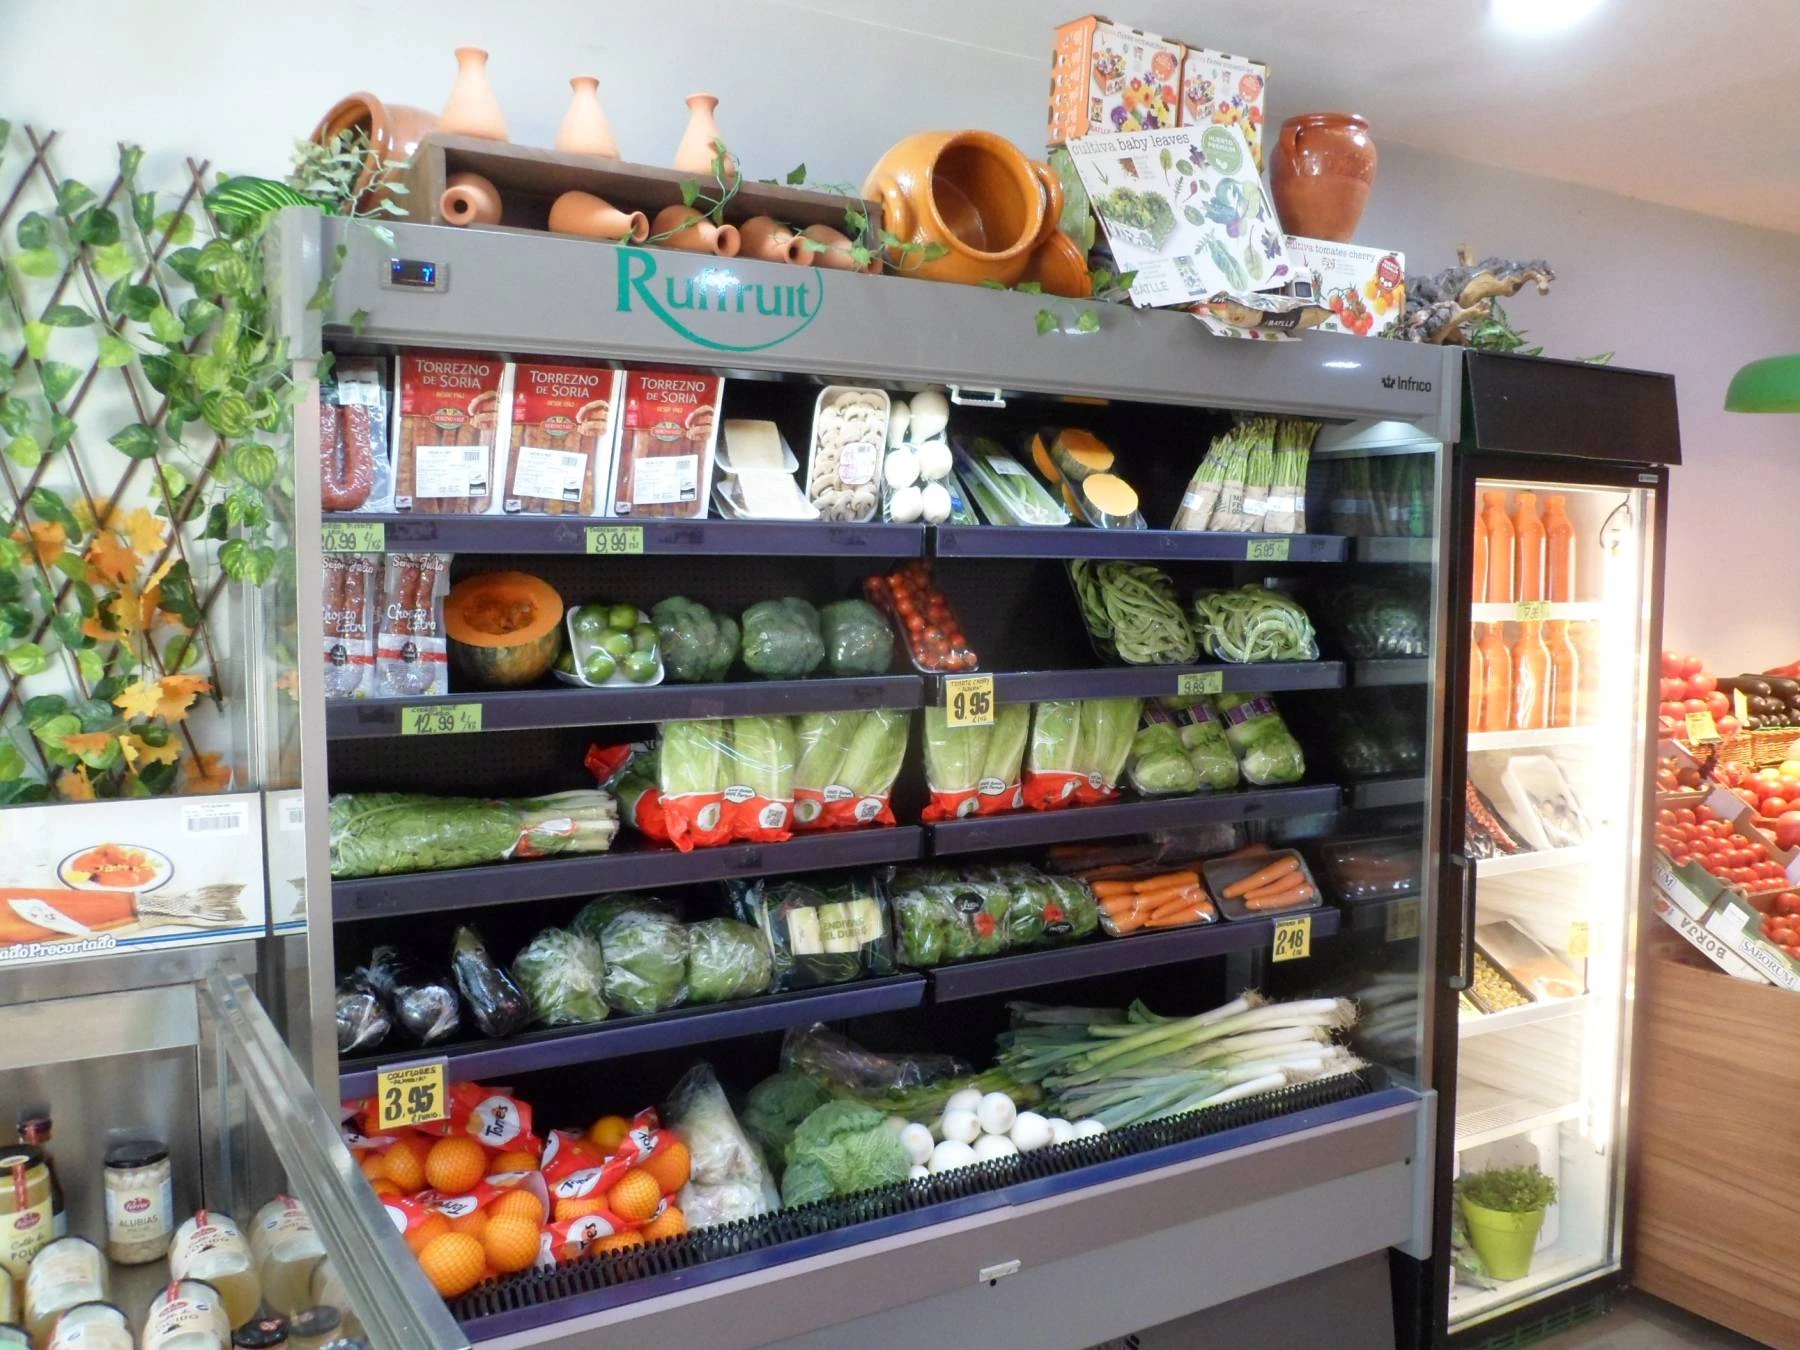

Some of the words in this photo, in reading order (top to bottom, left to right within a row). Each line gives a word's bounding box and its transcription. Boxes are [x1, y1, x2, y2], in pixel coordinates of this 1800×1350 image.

[1071, 140, 1116, 155] cultiva
[1117, 136, 1148, 151] baby
[1151, 133, 1190, 147] leaves
[1315, 245, 1347, 258] tomates
[1349, 250, 1376, 263] cherry
[416, 359, 490, 376] TORREZNO
[423, 375, 436, 385] DE
[440, 374, 481, 389] SORIA
[530, 370, 599, 386] TORREZNO
[640, 377, 706, 393] TORREZNO
[1397, 376, 1432, 392] Infrico
[536, 385, 548, 395] DE
[551, 383, 590, 399] SORIA
[646, 391, 658, 401] DE
[661, 391, 698, 405] SORIA
[414, 712, 455, 733] 12.99
[28, 934, 117, 958] Precortado
[386, 1065, 437, 1081] COLIFLORES
[119, 1213, 159, 1228] ALUBIAS
